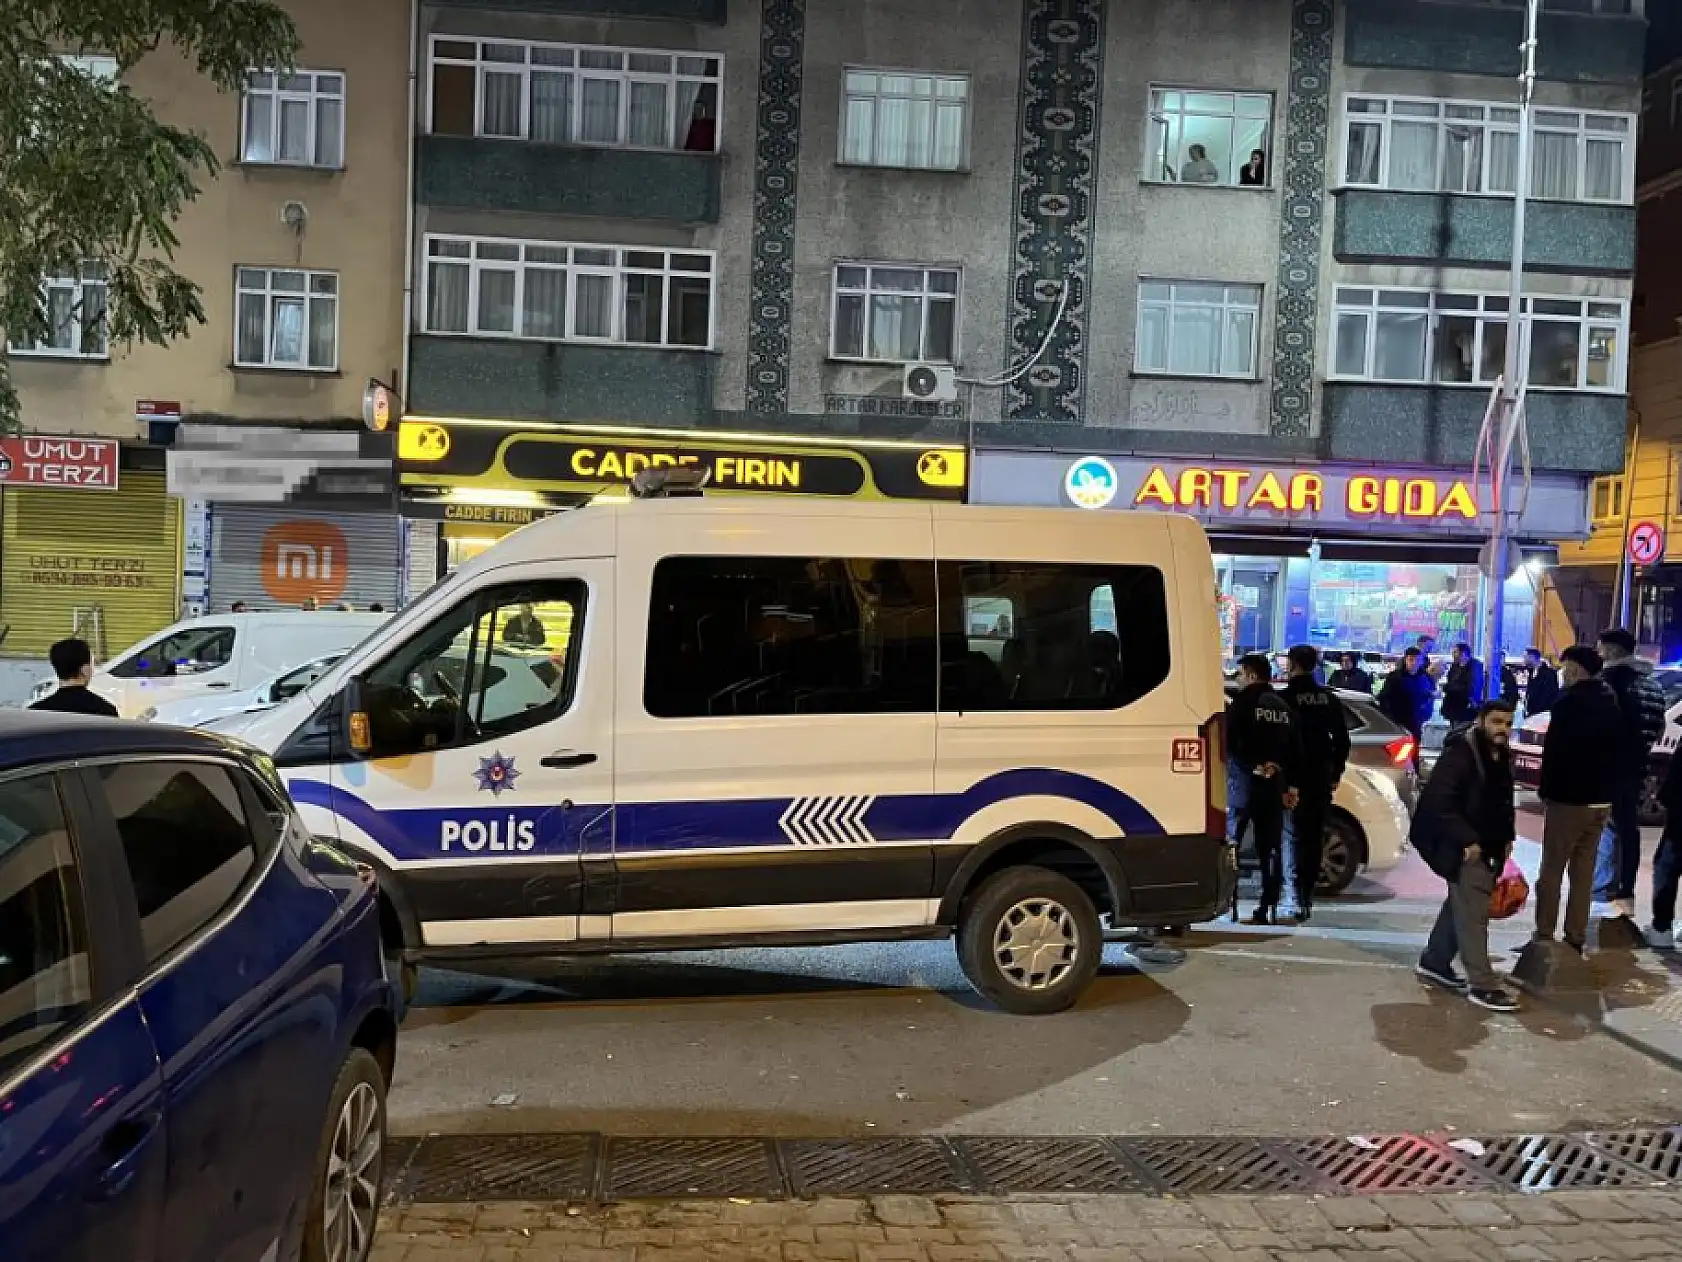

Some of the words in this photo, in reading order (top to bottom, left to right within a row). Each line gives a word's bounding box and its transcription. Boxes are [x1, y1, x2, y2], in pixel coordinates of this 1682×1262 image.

[24, 439, 107, 462] UMUT
[22, 462, 109, 485] TERZI
[715, 457, 800, 487] FIRIN
[1136, 467, 1323, 512] ARTAR
[1346, 476, 1478, 518] GIDA
[445, 504, 492, 520] CADDE
[494, 507, 532, 523] FIRIN
[1177, 742, 1199, 759] 112
[441, 813, 535, 852] POLİS
